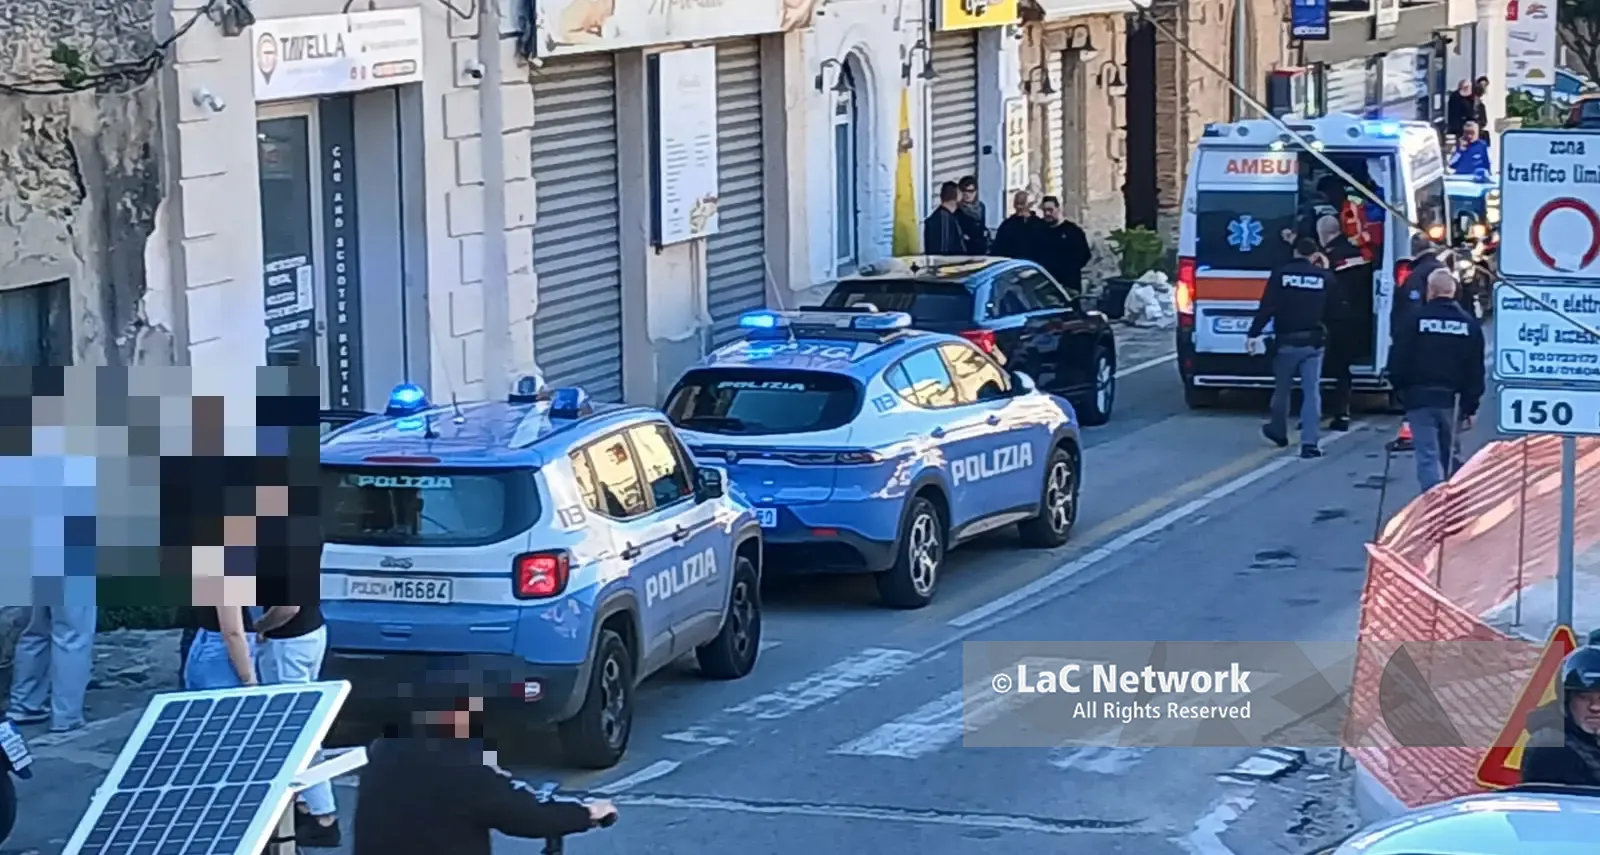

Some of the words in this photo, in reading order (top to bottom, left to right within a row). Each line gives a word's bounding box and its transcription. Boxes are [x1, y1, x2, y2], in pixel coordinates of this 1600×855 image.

[280, 33, 346, 62] TAVELLA
[1549, 140, 1586, 155] zona
[1507, 163, 1566, 183] traffico
[333, 192, 343, 228] AND
[1282, 274, 1325, 290] POLIZIA
[1418, 318, 1469, 336] POLIZIA
[716, 380, 805, 391] POLIZIA
[1510, 399, 1573, 426] 150
[951, 442, 1033, 487] POLIZIA
[357, 475, 453, 489] POLIZIA
[645, 546, 718, 608] POLIZIA
[393, 581, 448, 599] M6684
